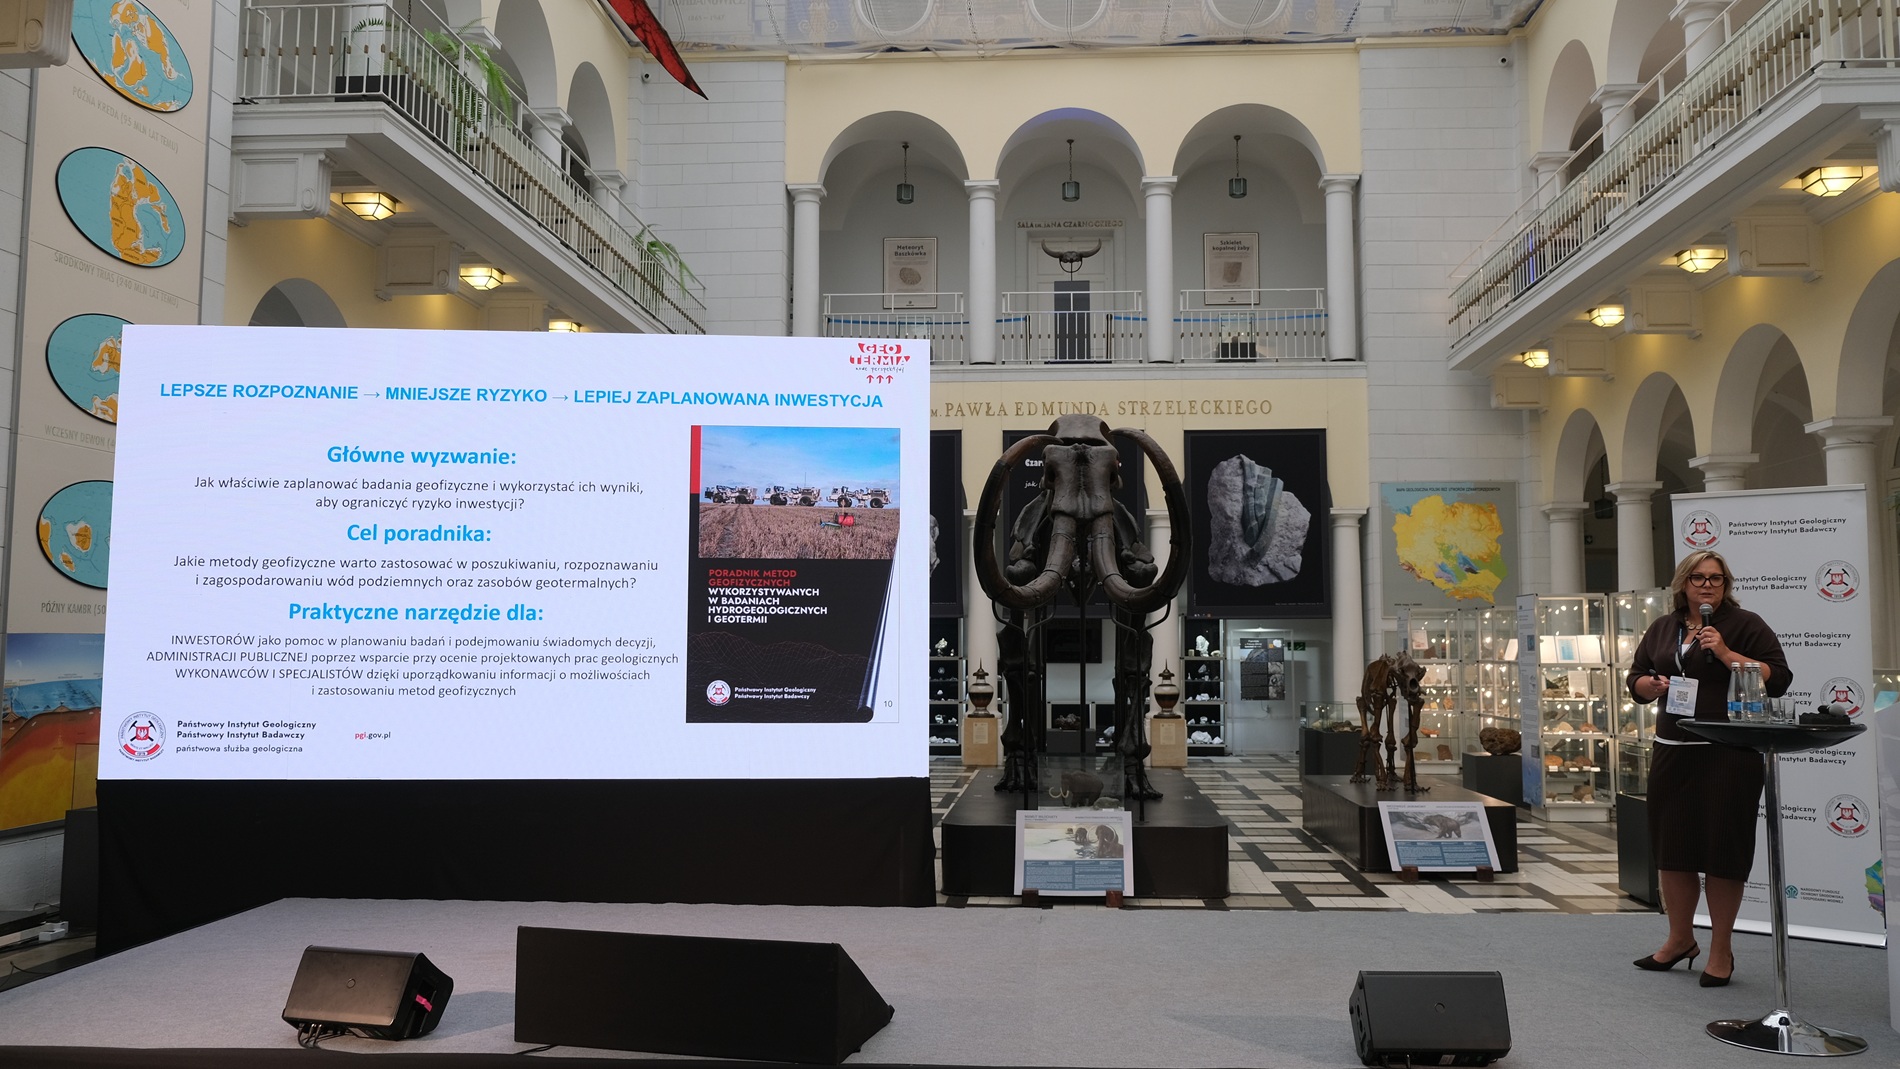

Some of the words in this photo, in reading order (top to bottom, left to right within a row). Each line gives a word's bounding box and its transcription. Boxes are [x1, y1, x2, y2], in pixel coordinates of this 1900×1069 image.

[97, 100, 119, 120] KREDA
[133, 122, 147, 135] MLN
[148, 128, 159, 141] LAT
[160, 135, 179, 154] TEMU)
[1063, 220, 1123, 228] CZARNOCKIEGO
[96, 268, 115, 283] TRIAS
[149, 288, 160, 300] LAT
[858, 343, 902, 354] GEO
[850, 355, 911, 365] TERMIA
[161, 384, 227, 397] LEPSZE
[233, 384, 358, 399] ROZPOZNANIE
[386, 387, 471, 401] MNIEJSZE
[477, 388, 547, 402] RYZYKO
[574, 390, 631, 403] LEPIEJ
[636, 391, 770, 406] ZAPLANOWANA
[775, 394, 883, 407] INWESTYCJA
[945, 402, 1008, 417] PAWŁA
[1015, 402, 1109, 419] EDMUNDA
[1118, 400, 1272, 418] STRZELECKIEGO
[44, 424, 78, 440] WCZESNY
[327, 446, 405, 463] Główne
[411, 448, 516, 467] wyzwanie:
[1025, 459, 1044, 467] Czar
[195, 477, 214, 487] Jak
[219, 477, 279, 488] właściwie
[284, 478, 357, 491] zaplanować
[362, 479, 411, 490] badania
[416, 479, 488, 493] geofizyczne
[500, 481, 574, 494] wykorzystać
[579, 482, 595, 492] ich
[600, 482, 643, 494] wyniki,
[316, 497, 338, 509] aby
[342, 497, 408, 510] ograniczyć
[412, 498, 451, 510] ryzyko
[456, 498, 524, 511] inwestycji?
[1728, 520, 1768, 528] Państwowy
[1770, 519, 1798, 527] Instytut
[1799, 517, 1847, 526] Geologiczny
[347, 524, 377, 541] Cel
[384, 525, 491, 544] poradnika:
[1729, 528, 1768, 536] Państwowy
[1770, 527, 1798, 535] Instytut
[1800, 525, 1838, 534] Badawczy
[174, 556, 205, 566] Jakie
[210, 556, 258, 569] metody
[262, 556, 335, 570] geofizyczne
[340, 559, 376, 568] warto
[381, 558, 452, 569] zastosować
[472, 559, 559, 571] poszukiwaniu,
[565, 560, 657, 572] rozpoznawaniu
[709, 569, 759, 577] PORADNIK
[203, 575, 322, 588] zagospodarowaniu
[327, 575, 354, 586] wód
[359, 576, 442, 589] podziemnych
[447, 579, 473, 587] oraz
[478, 577, 532, 587] zasobów
[536, 578, 636, 590] geotermalnych?
[1770, 583, 1808, 591] Badawczy
[708, 588, 819, 596] WYKORZYSTYWANYCH
[722, 597, 779, 605] BADANIACH
[41, 600, 66, 614] PÓŹNY
[67, 604, 92, 615] KAMBR
[289, 602, 398, 624] Praktyczne
[405, 603, 500, 624] narzędzie
[507, 604, 543, 621] dla:
[708, 606, 827, 614] HYDROGEOLOGICZNYCH
[714, 615, 767, 623] GEOTERMII
[171, 633, 255, 646] INWESTORÓW
[258, 635, 281, 647] jako
[285, 638, 324, 648] pomoc
[341, 636, 407, 648] planowaniu
[411, 636, 445, 646] badań
[455, 636, 540, 649] podejmowaniu
[543, 637, 612, 649] świadomych
[615, 637, 656, 649] decyzji,
[1804, 632, 1851, 640] Geologiczny
[147, 652, 236, 661] ADMINISTRACJI
[241, 652, 307, 662] PUBLICZNEJ
[312, 655, 355, 664] poprzez
[360, 653, 409, 664] wsparcie
[413, 655, 436, 665] przy
[440, 653, 477, 662] ocenie
[481, 653, 570, 665] projektowanych
[575, 656, 598, 665] prac
[601, 653, 678, 665] geologicznych
[175, 666, 269, 678] WYKONAWCÓW
[279, 667, 363, 679] SPECJALISTÓW
[367, 669, 399, 681] dzięki
[403, 669, 496, 681] uporządkowaniu
[500, 669, 555, 682] informacji
[570, 670, 650, 680] możliwościach
[318, 686, 394, 695] zastosowaniu
[399, 686, 435, 695] metod
[439, 685, 515, 698] geofizycznych
[1785, 690, 1812, 698] ogiczny
[178, 721, 225, 729] Państwowy
[228, 721, 259, 729] Instytut
[262, 720, 316, 730] Geologiczny
[177, 731, 224, 740] Państwowy
[227, 731, 259, 740] Instytut
[262, 731, 305, 740] Badawczy
[355, 732, 391, 740] pgi.gov.pl
[176, 745, 220, 753] państwowa
[253, 744, 302, 754] geologiczna
[1809, 757, 1847, 765] Badawczy
[1781, 805, 1817, 814] ologiczny
